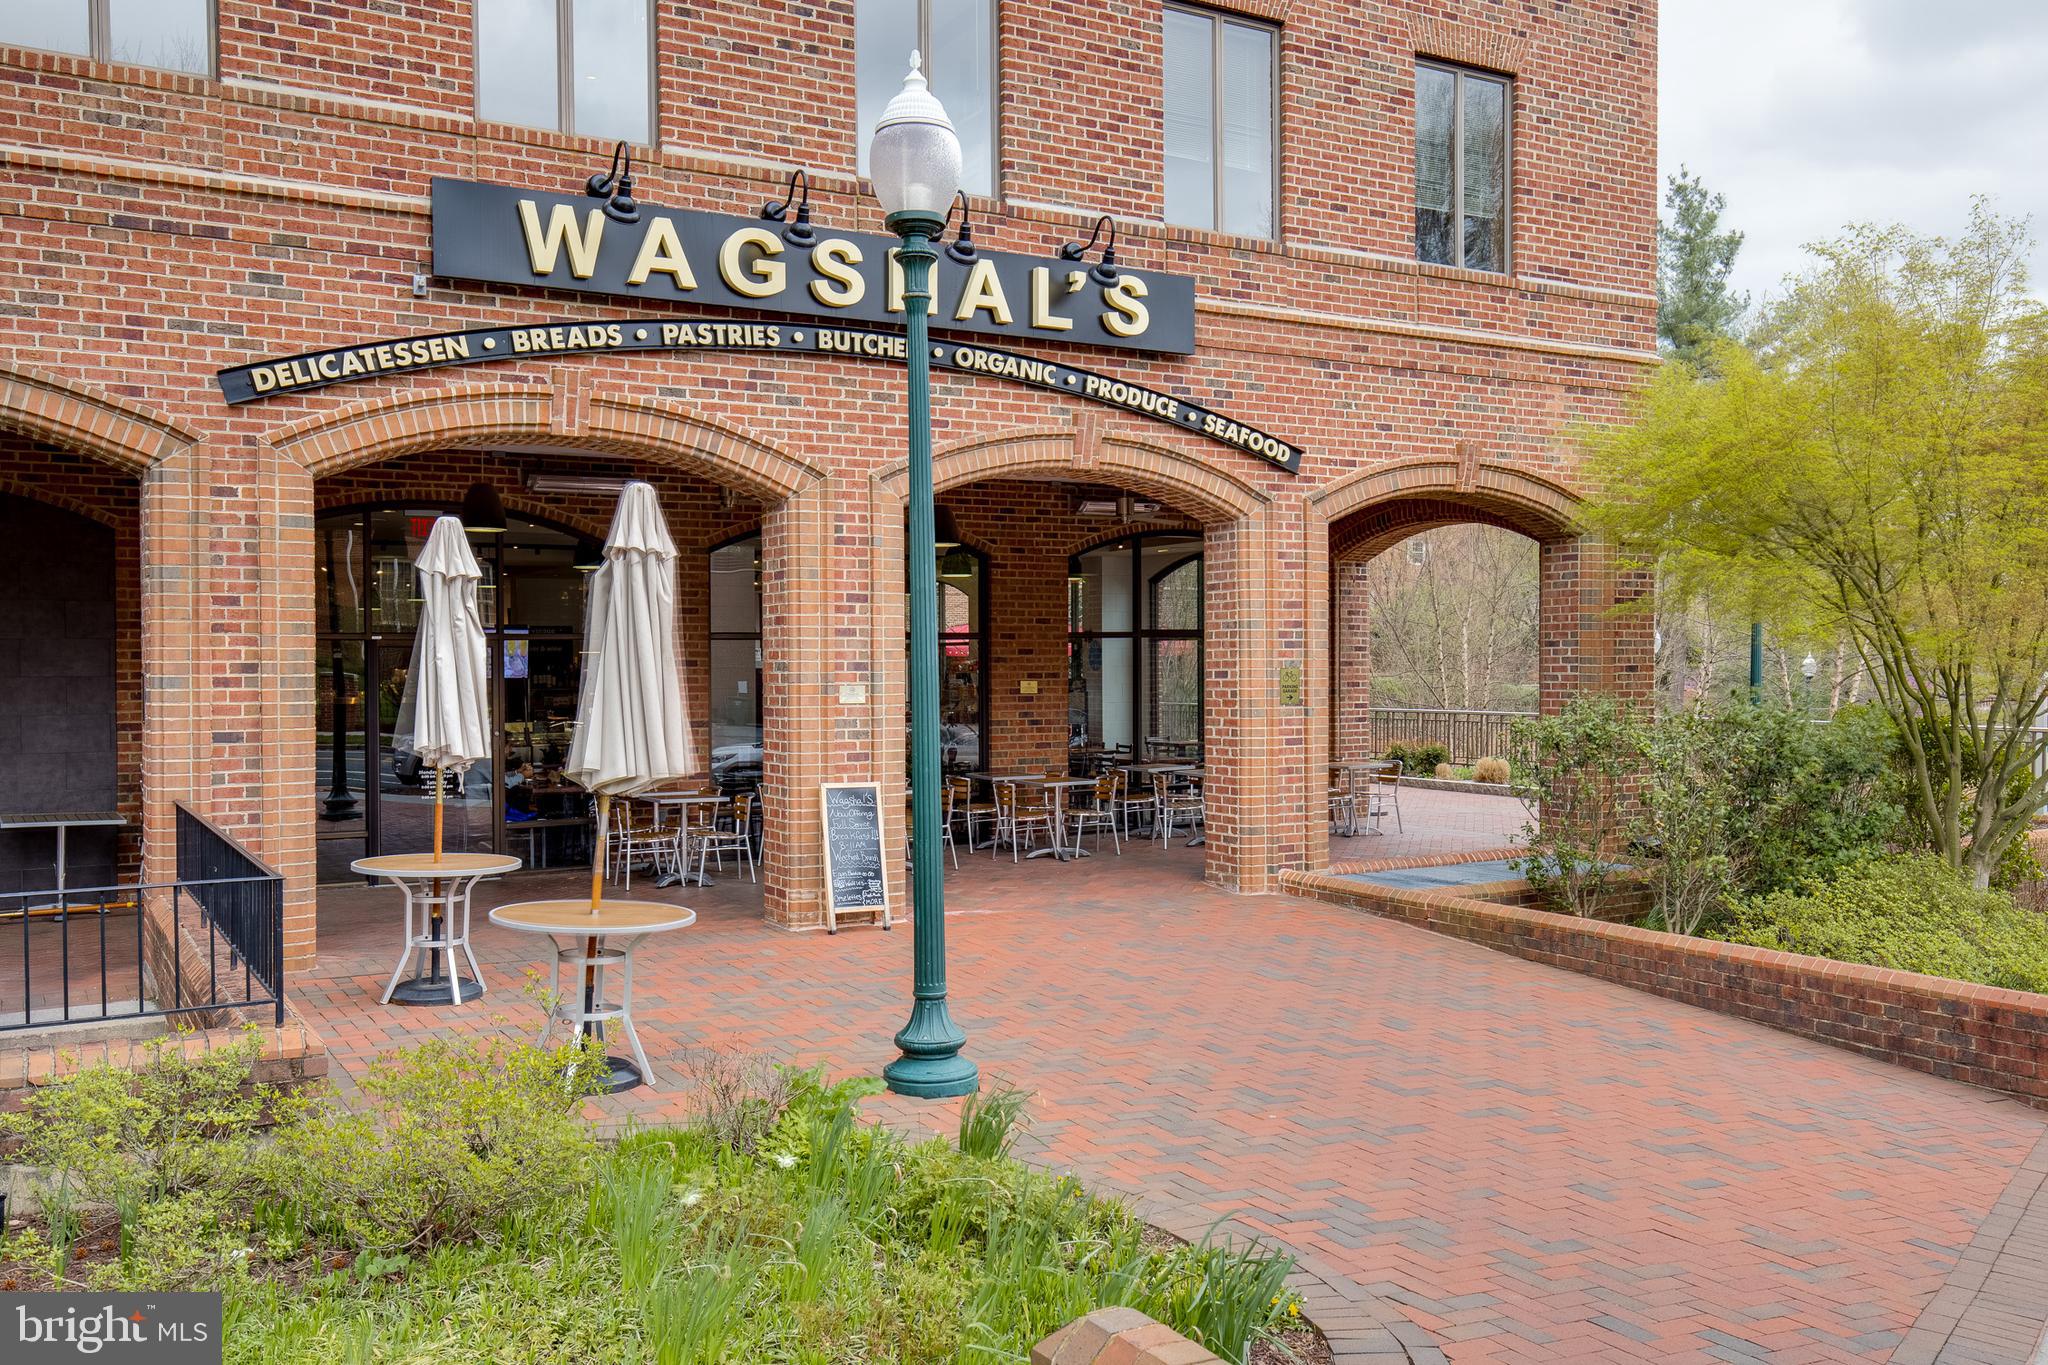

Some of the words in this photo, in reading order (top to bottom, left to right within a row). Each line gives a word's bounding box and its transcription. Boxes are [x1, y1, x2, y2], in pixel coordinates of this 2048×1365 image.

[250, 335, 470, 392] DELICATESSEN
[511, 324, 623, 353] BREADS
[662, 323, 781, 347] PASTRIES
[817, 329, 909, 359] BUTCHE
[955, 347, 1057, 385] ORGANIC
[1086, 375, 1178, 420] PRODUCE
[1203, 414, 1291, 463] SEAFOOD
